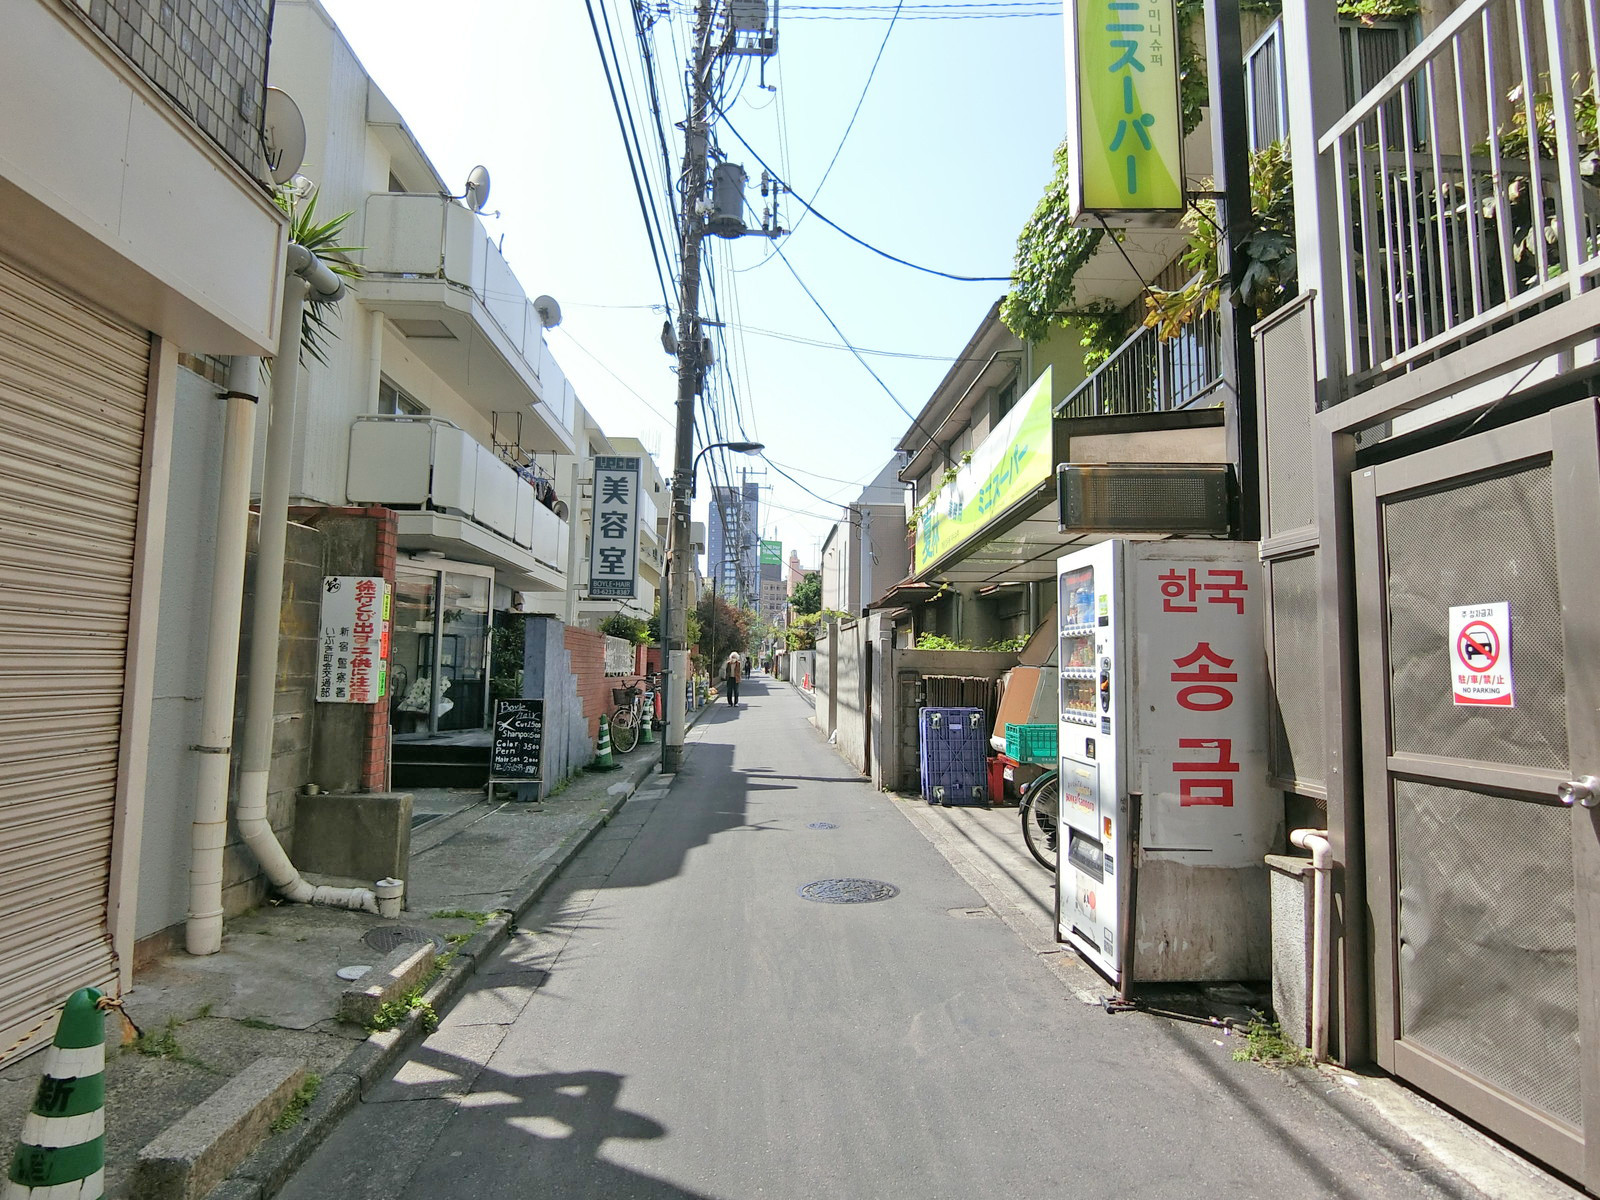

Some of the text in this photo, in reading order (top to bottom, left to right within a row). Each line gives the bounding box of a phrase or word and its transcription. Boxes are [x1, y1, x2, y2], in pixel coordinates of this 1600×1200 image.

[978, 444, 1028, 514] ミニスーパー
[598, 476, 630, 575] 美容室
[1157, 567, 1249, 615] 한국
[335, 626, 350, 698] 新宿警察署
[1473, 686, 1501, 694] PARKING
[496, 739, 540, 750] Color 3500
